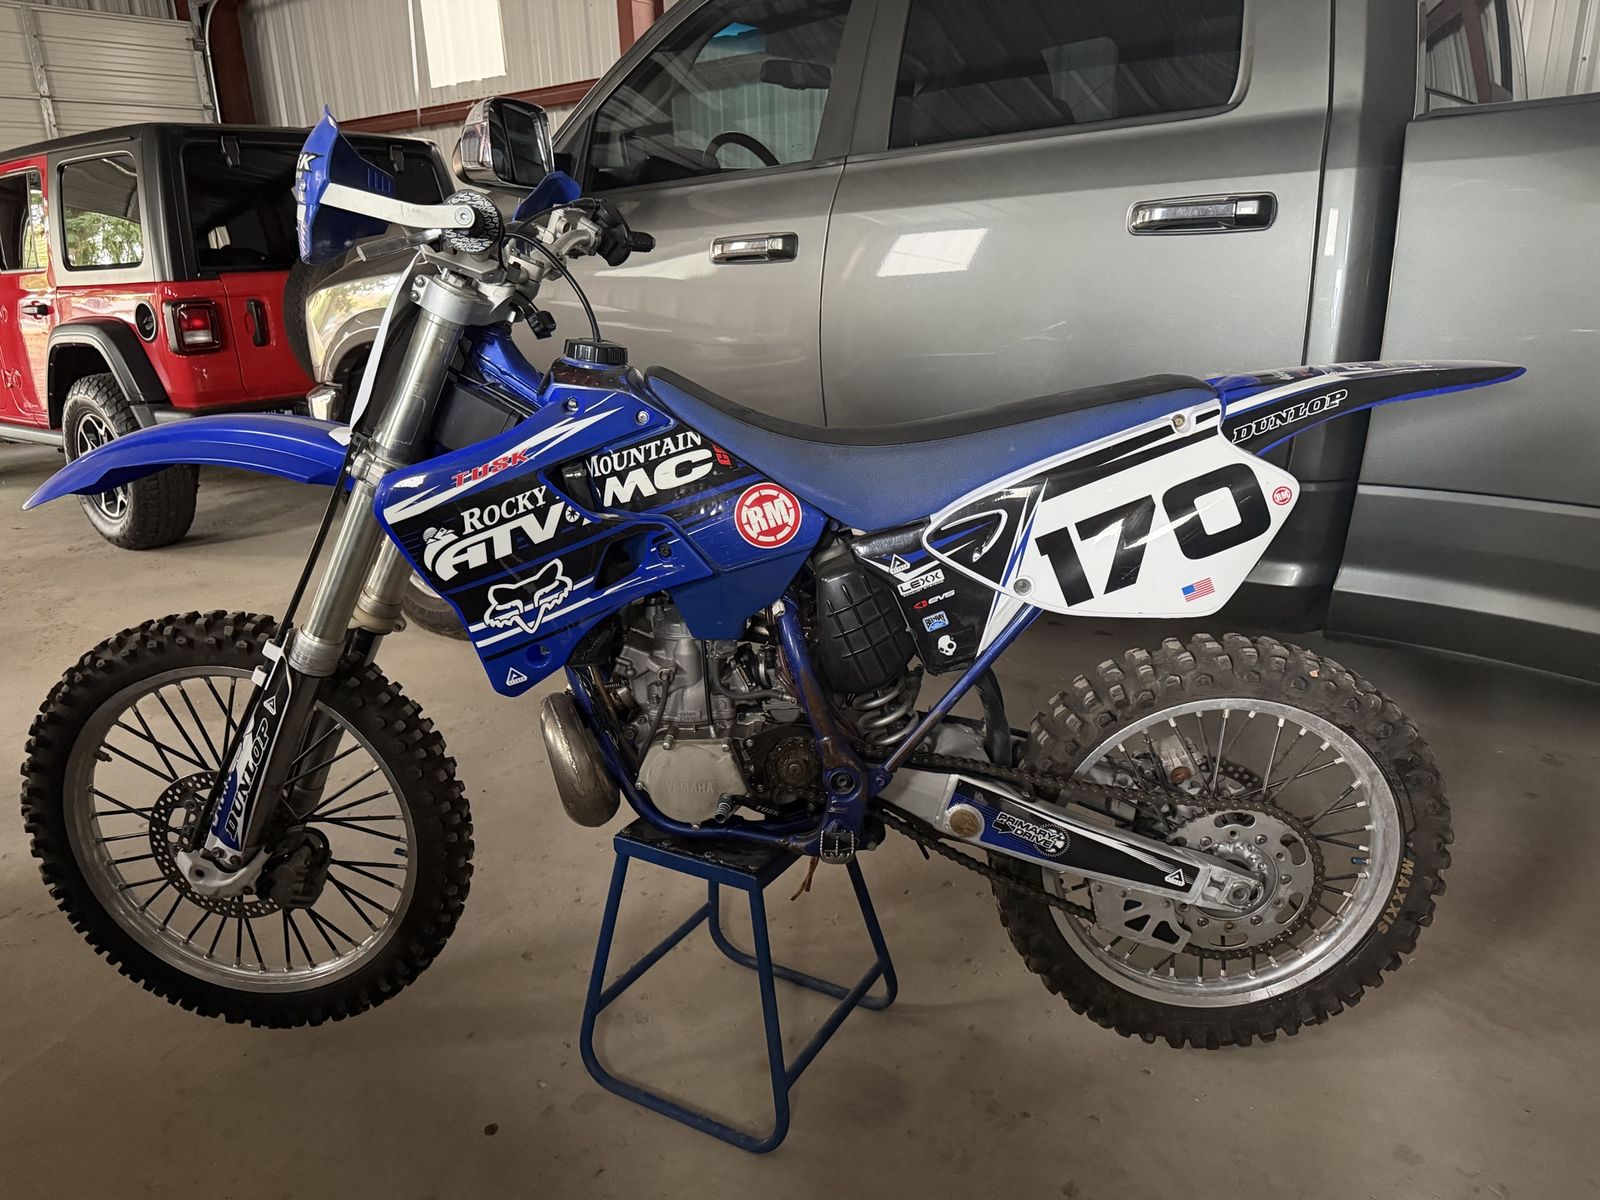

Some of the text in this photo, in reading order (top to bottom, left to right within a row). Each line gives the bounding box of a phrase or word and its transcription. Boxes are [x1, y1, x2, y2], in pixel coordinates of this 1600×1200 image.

[1232, 389, 1348, 444] DUNLOP
[452, 448, 529, 488] TUSK
[461, 485, 547, 536] ROCKY
[585, 431, 702, 478] MOUNTAIN
[435, 449, 713, 582] ATV MC
[1273, 488, 1292, 503] RM
[1034, 462, 1271, 607] 170
[900, 572, 941, 593] LEXX
[225, 717, 269, 841] DUNLOP
[665, 782, 714, 793] YAMAHA
[755, 805, 780, 817] TUSK
[996, 811, 1059, 841] PRIMARY
[1012, 828, 1056, 849] DRIVE
[1377, 857, 1415, 935] MAXXIS
